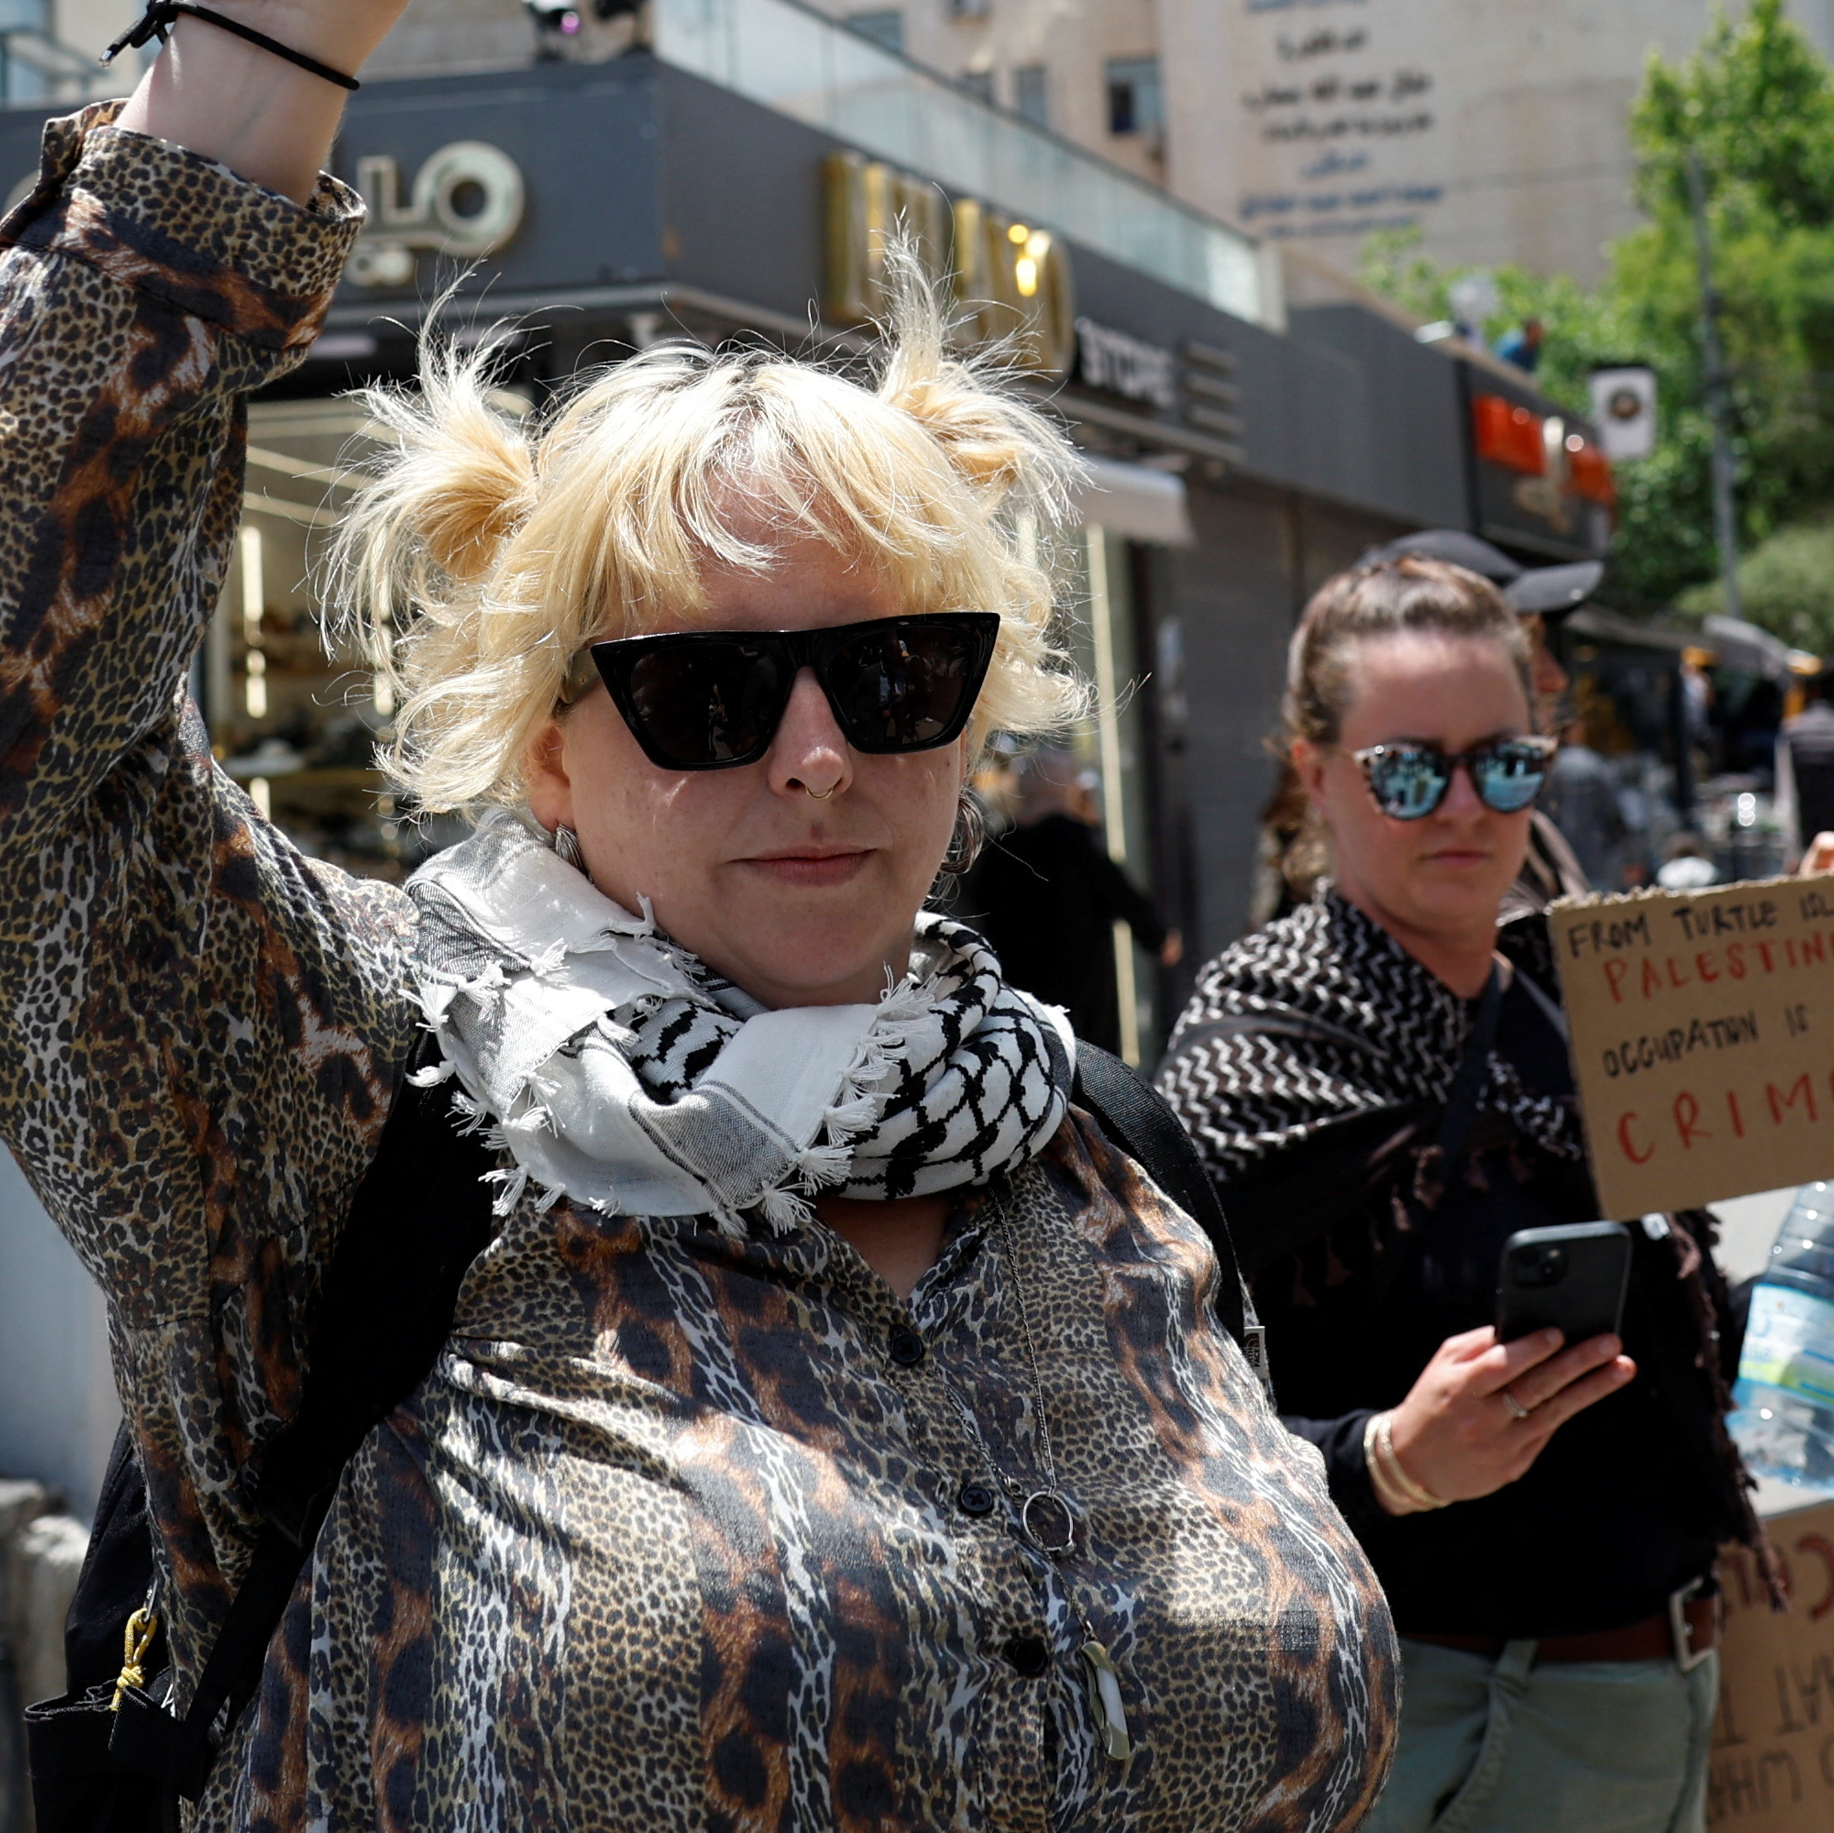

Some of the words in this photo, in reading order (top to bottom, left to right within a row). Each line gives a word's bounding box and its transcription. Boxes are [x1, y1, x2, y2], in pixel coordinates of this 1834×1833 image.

[1567, 911, 1652, 959] FROM
[1673, 899, 1778, 942] TURTLE
[1785, 1002, 1809, 1038] IS
